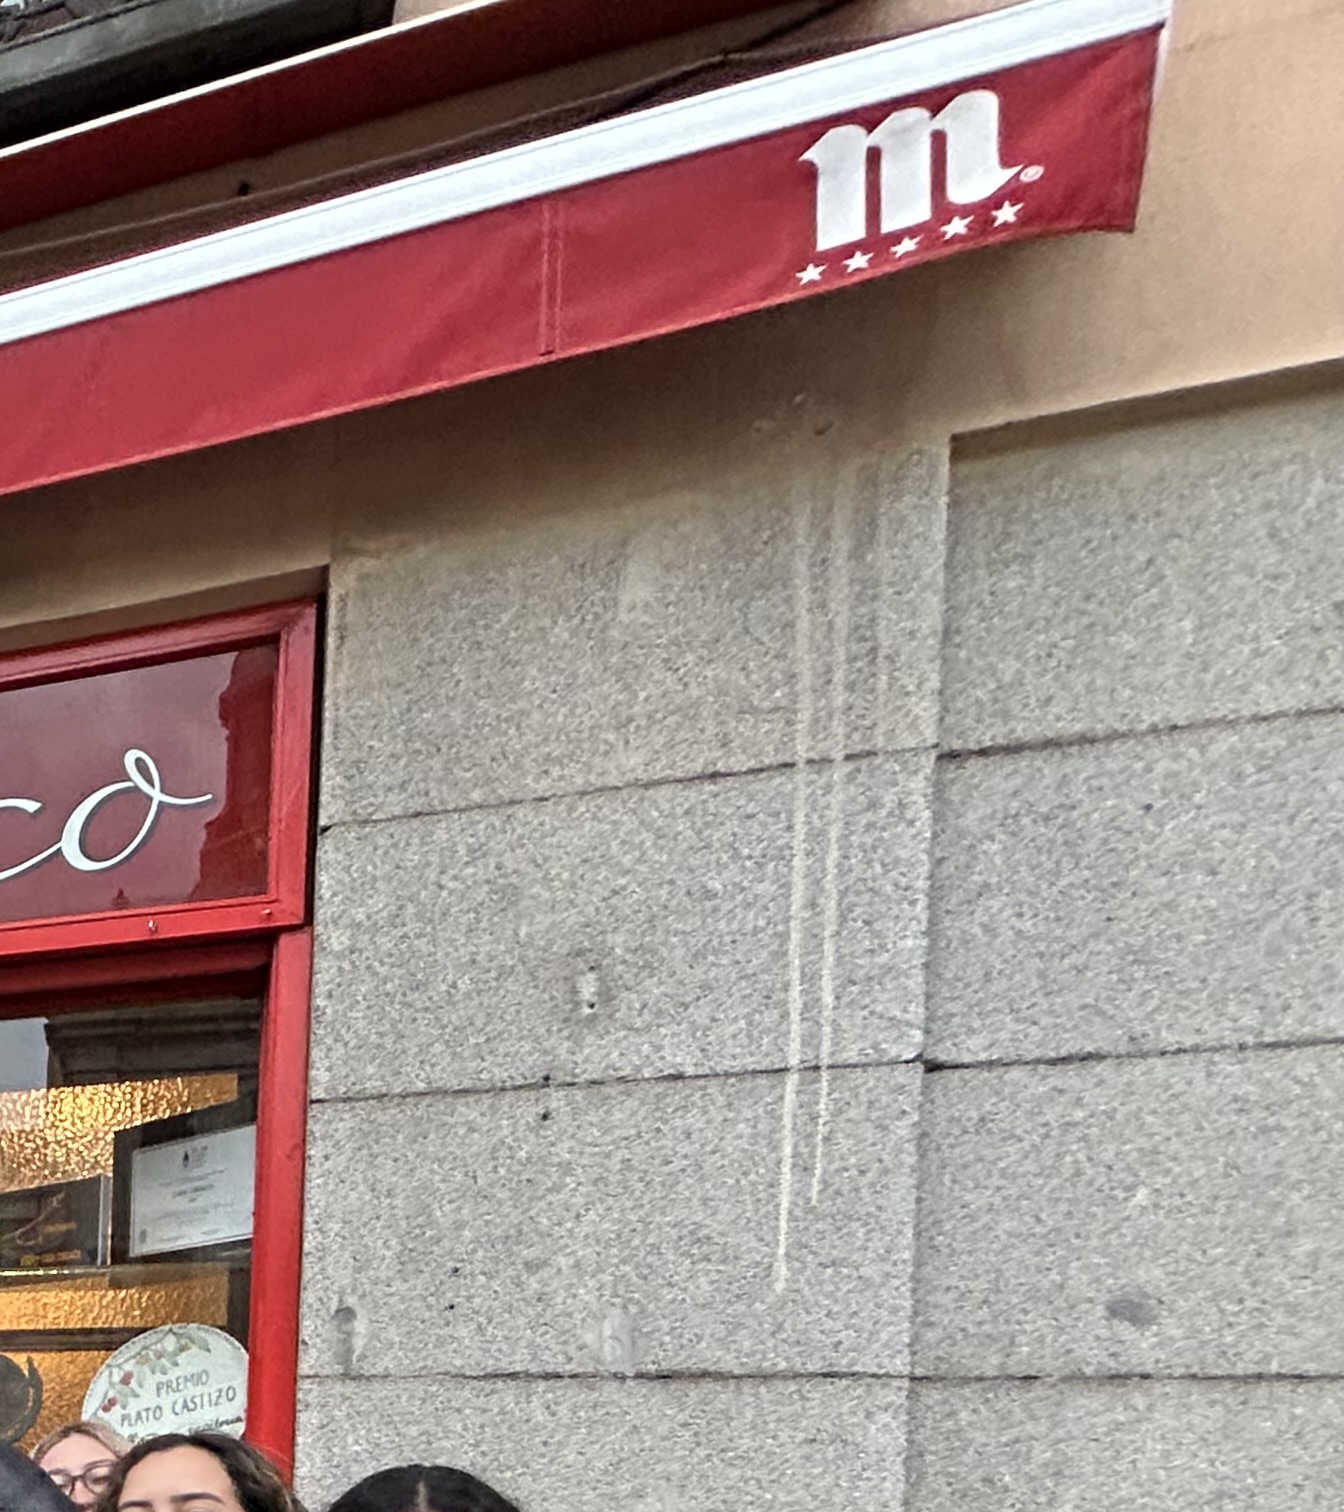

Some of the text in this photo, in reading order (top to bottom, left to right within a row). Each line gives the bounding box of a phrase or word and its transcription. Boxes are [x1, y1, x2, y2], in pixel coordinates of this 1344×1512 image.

[155, 1369, 210, 1399] PREMIO
[120, 1405, 163, 1429] PLATO
[171, 1385, 237, 1416] CASTIZO
